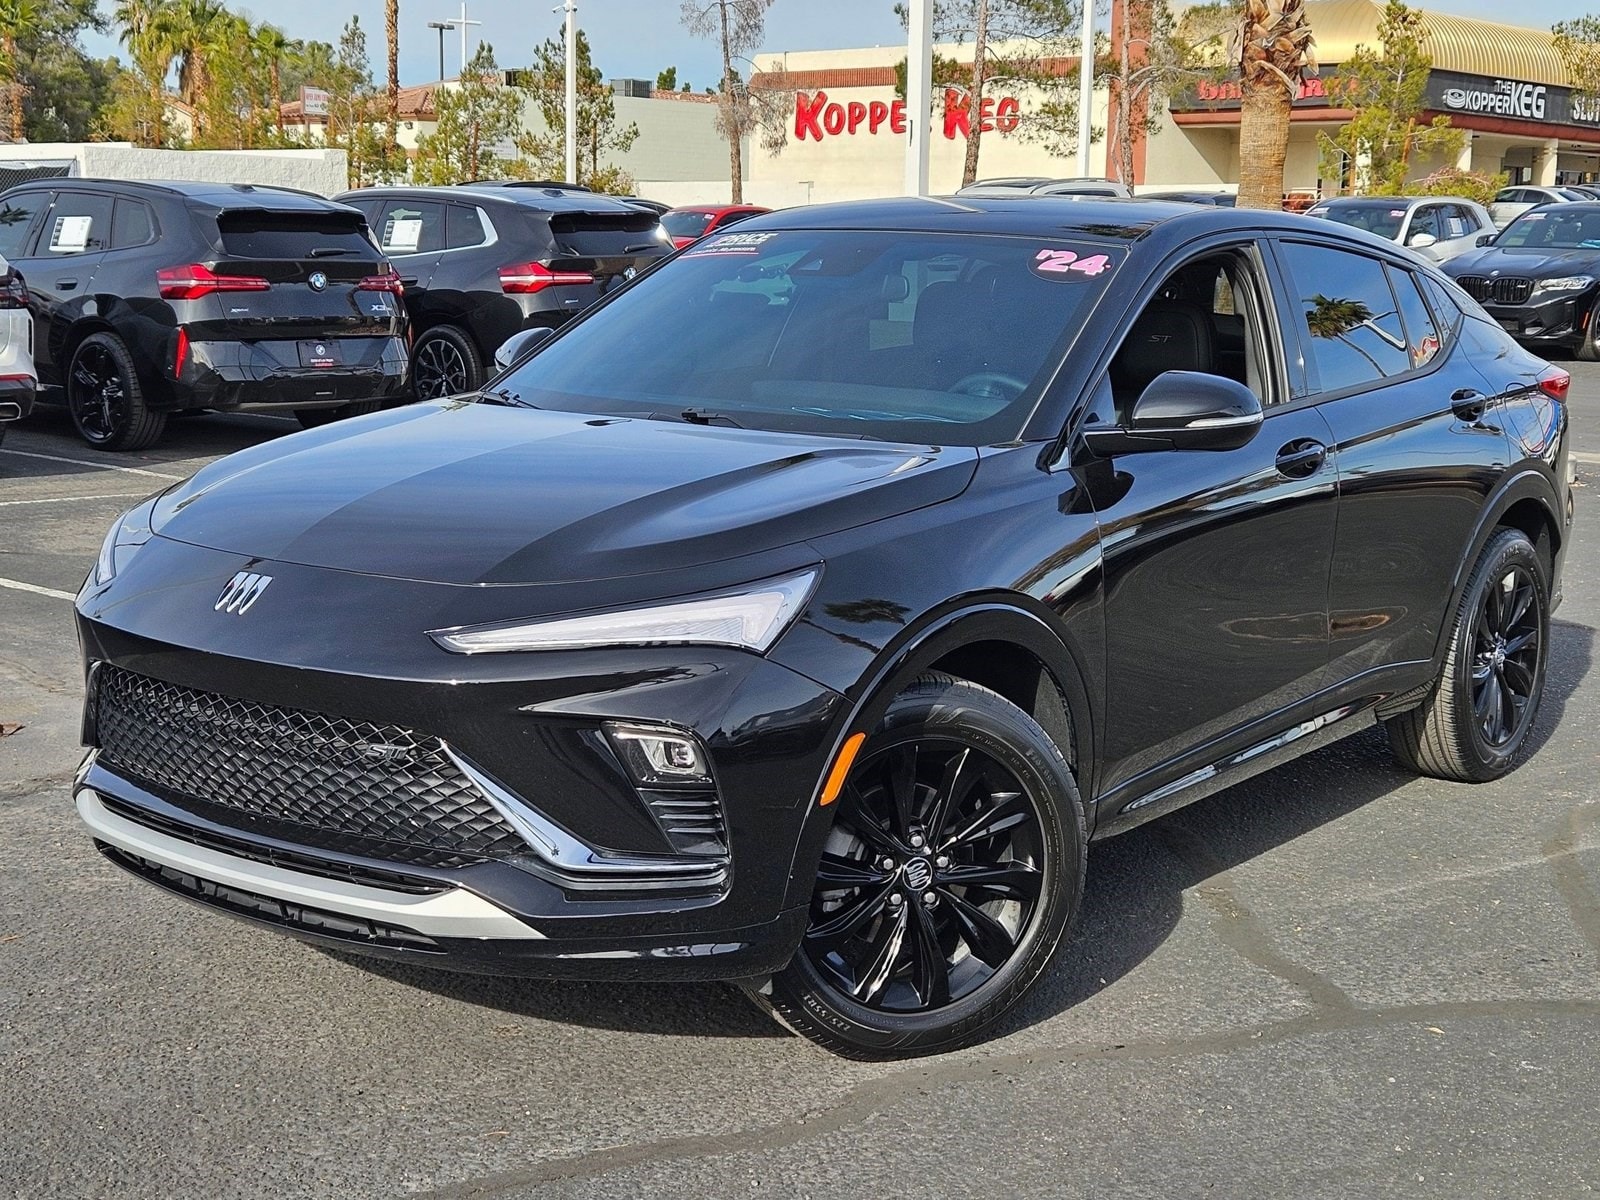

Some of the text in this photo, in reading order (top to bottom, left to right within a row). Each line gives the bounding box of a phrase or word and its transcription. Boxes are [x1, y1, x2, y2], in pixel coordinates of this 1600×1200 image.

[1495, 80, 1511, 94] THE
[1465, 82, 1546, 119] KOPPER KEG
[795, 91, 907, 142] KOPPE
[1150, 334, 1172, 343] ST
[364, 743, 409, 759] ST
